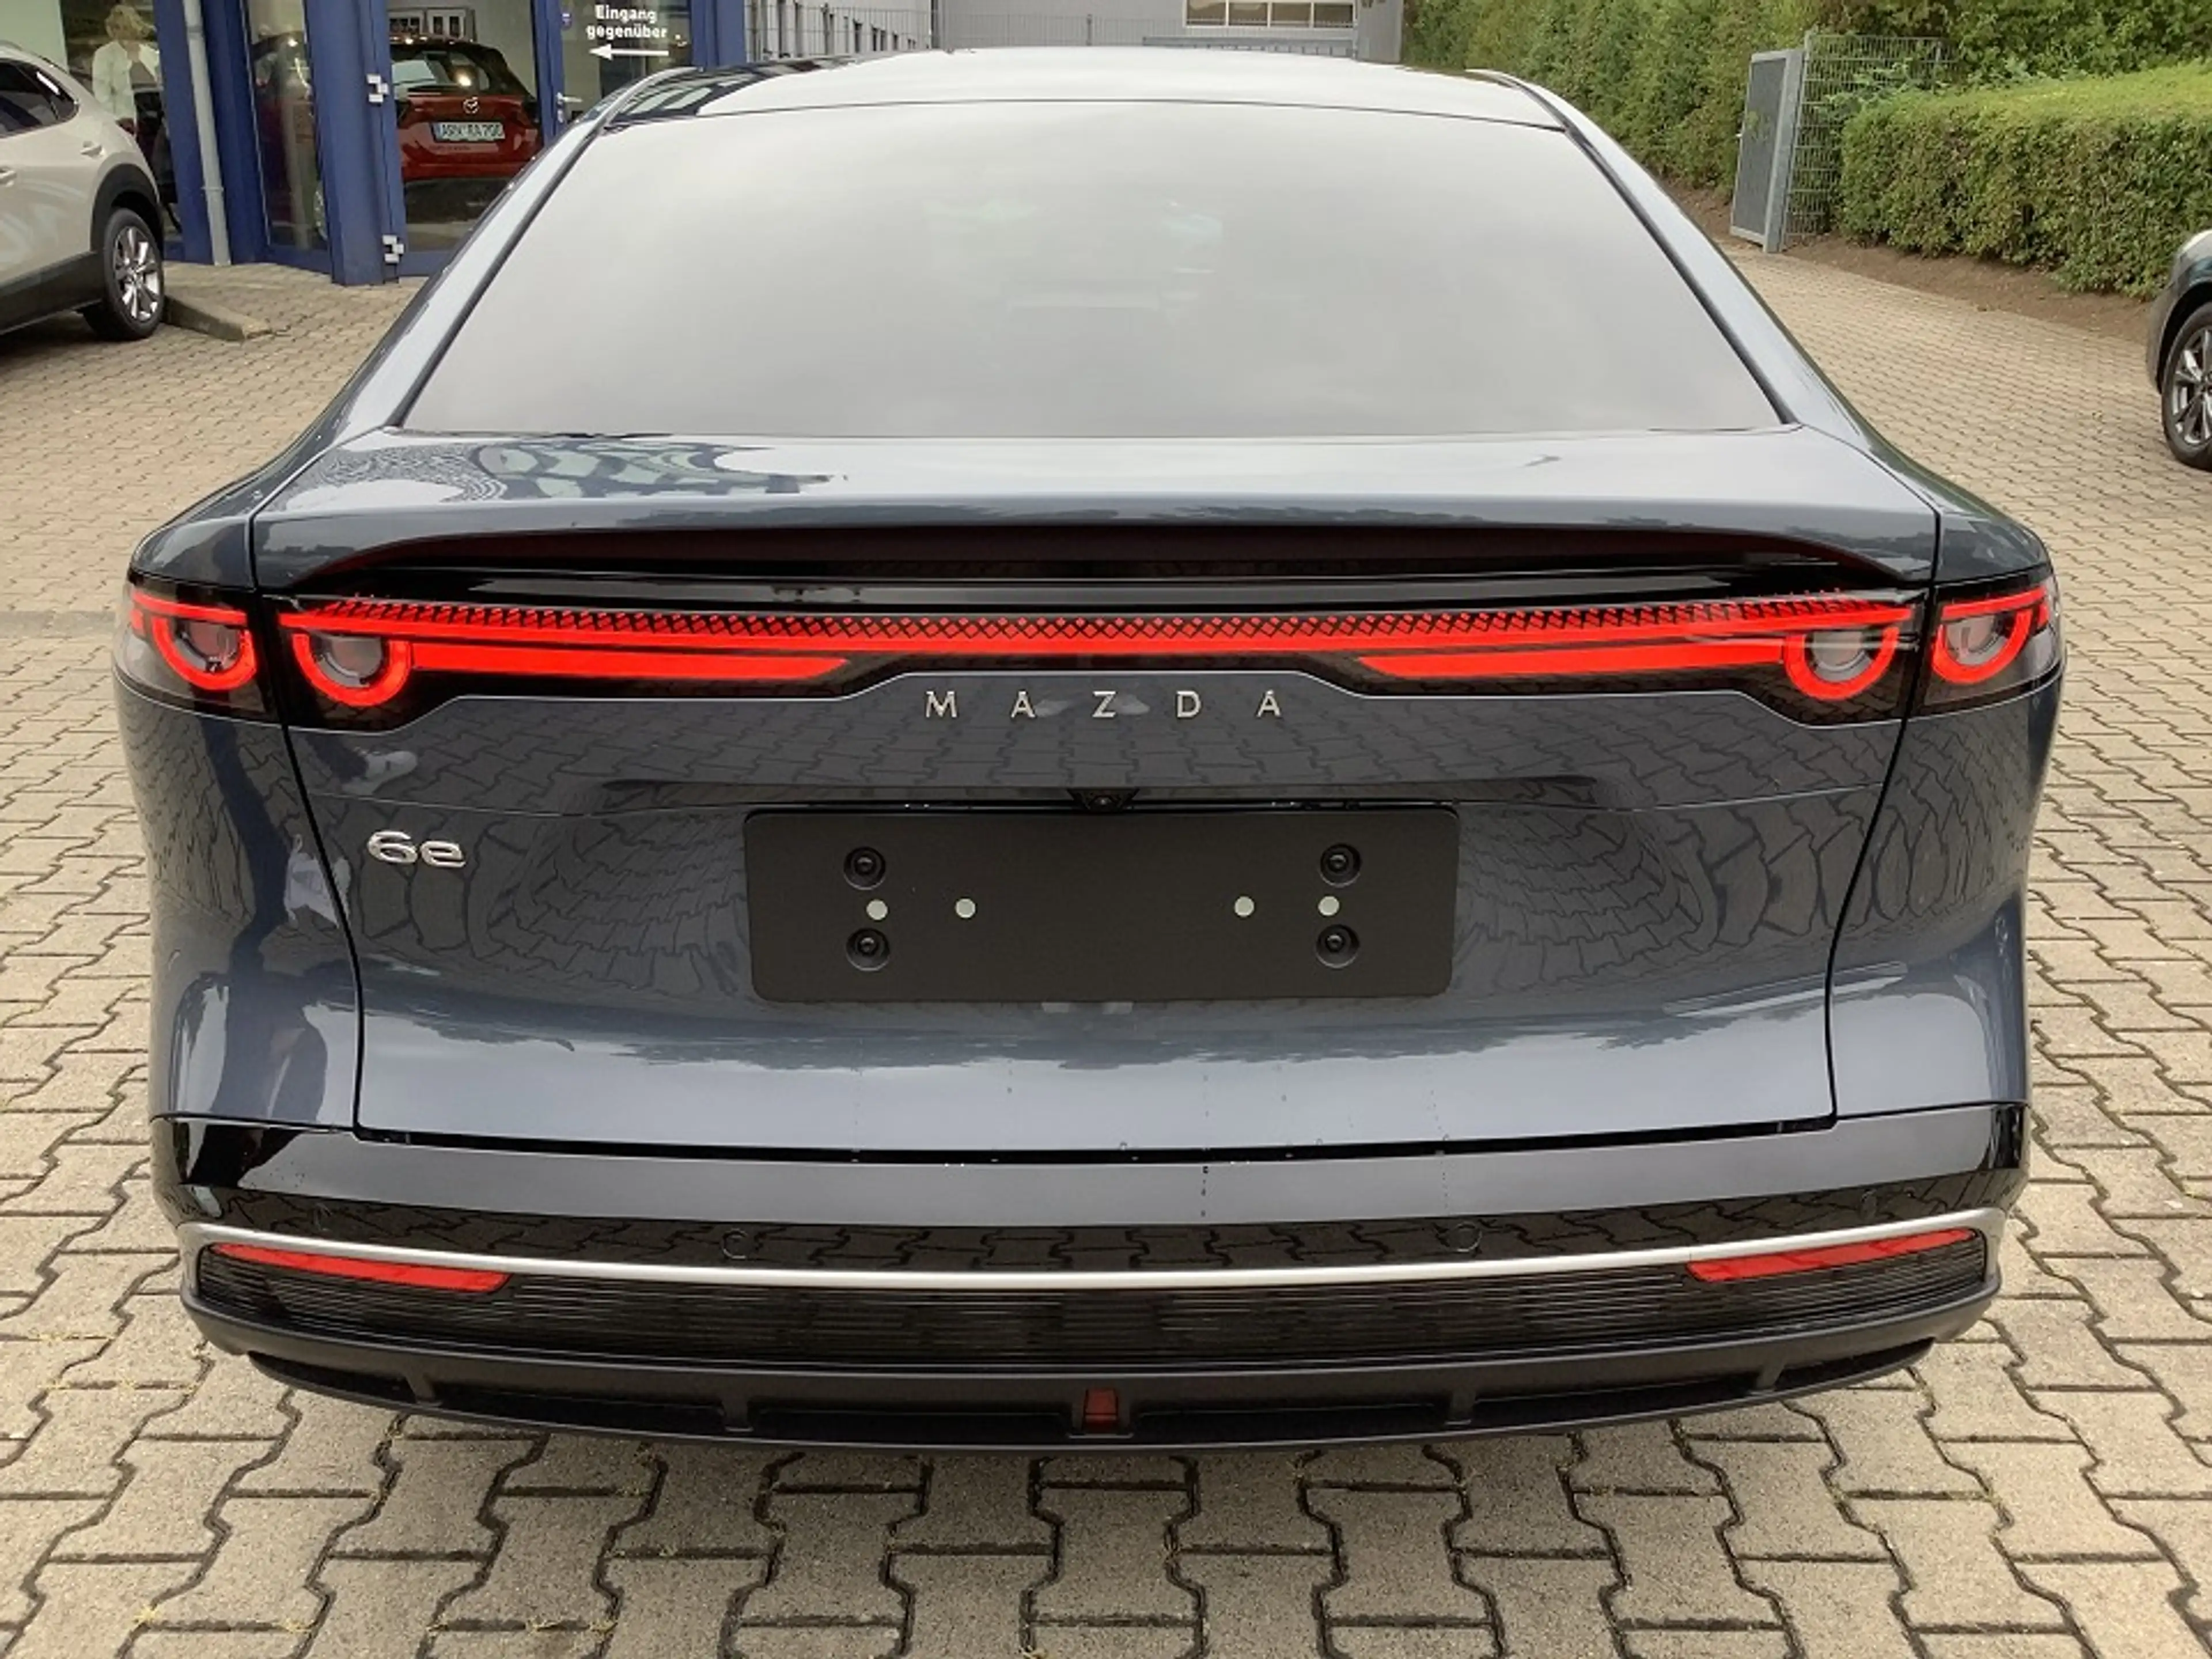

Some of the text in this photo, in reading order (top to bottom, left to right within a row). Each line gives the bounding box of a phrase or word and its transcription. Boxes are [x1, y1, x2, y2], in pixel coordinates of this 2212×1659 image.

[594, 4, 658, 24] Eingang
[586, 23, 668, 40] gegenüber
[925, 691, 1281, 718] MAZDA
[367, 830, 467, 868] 6e
